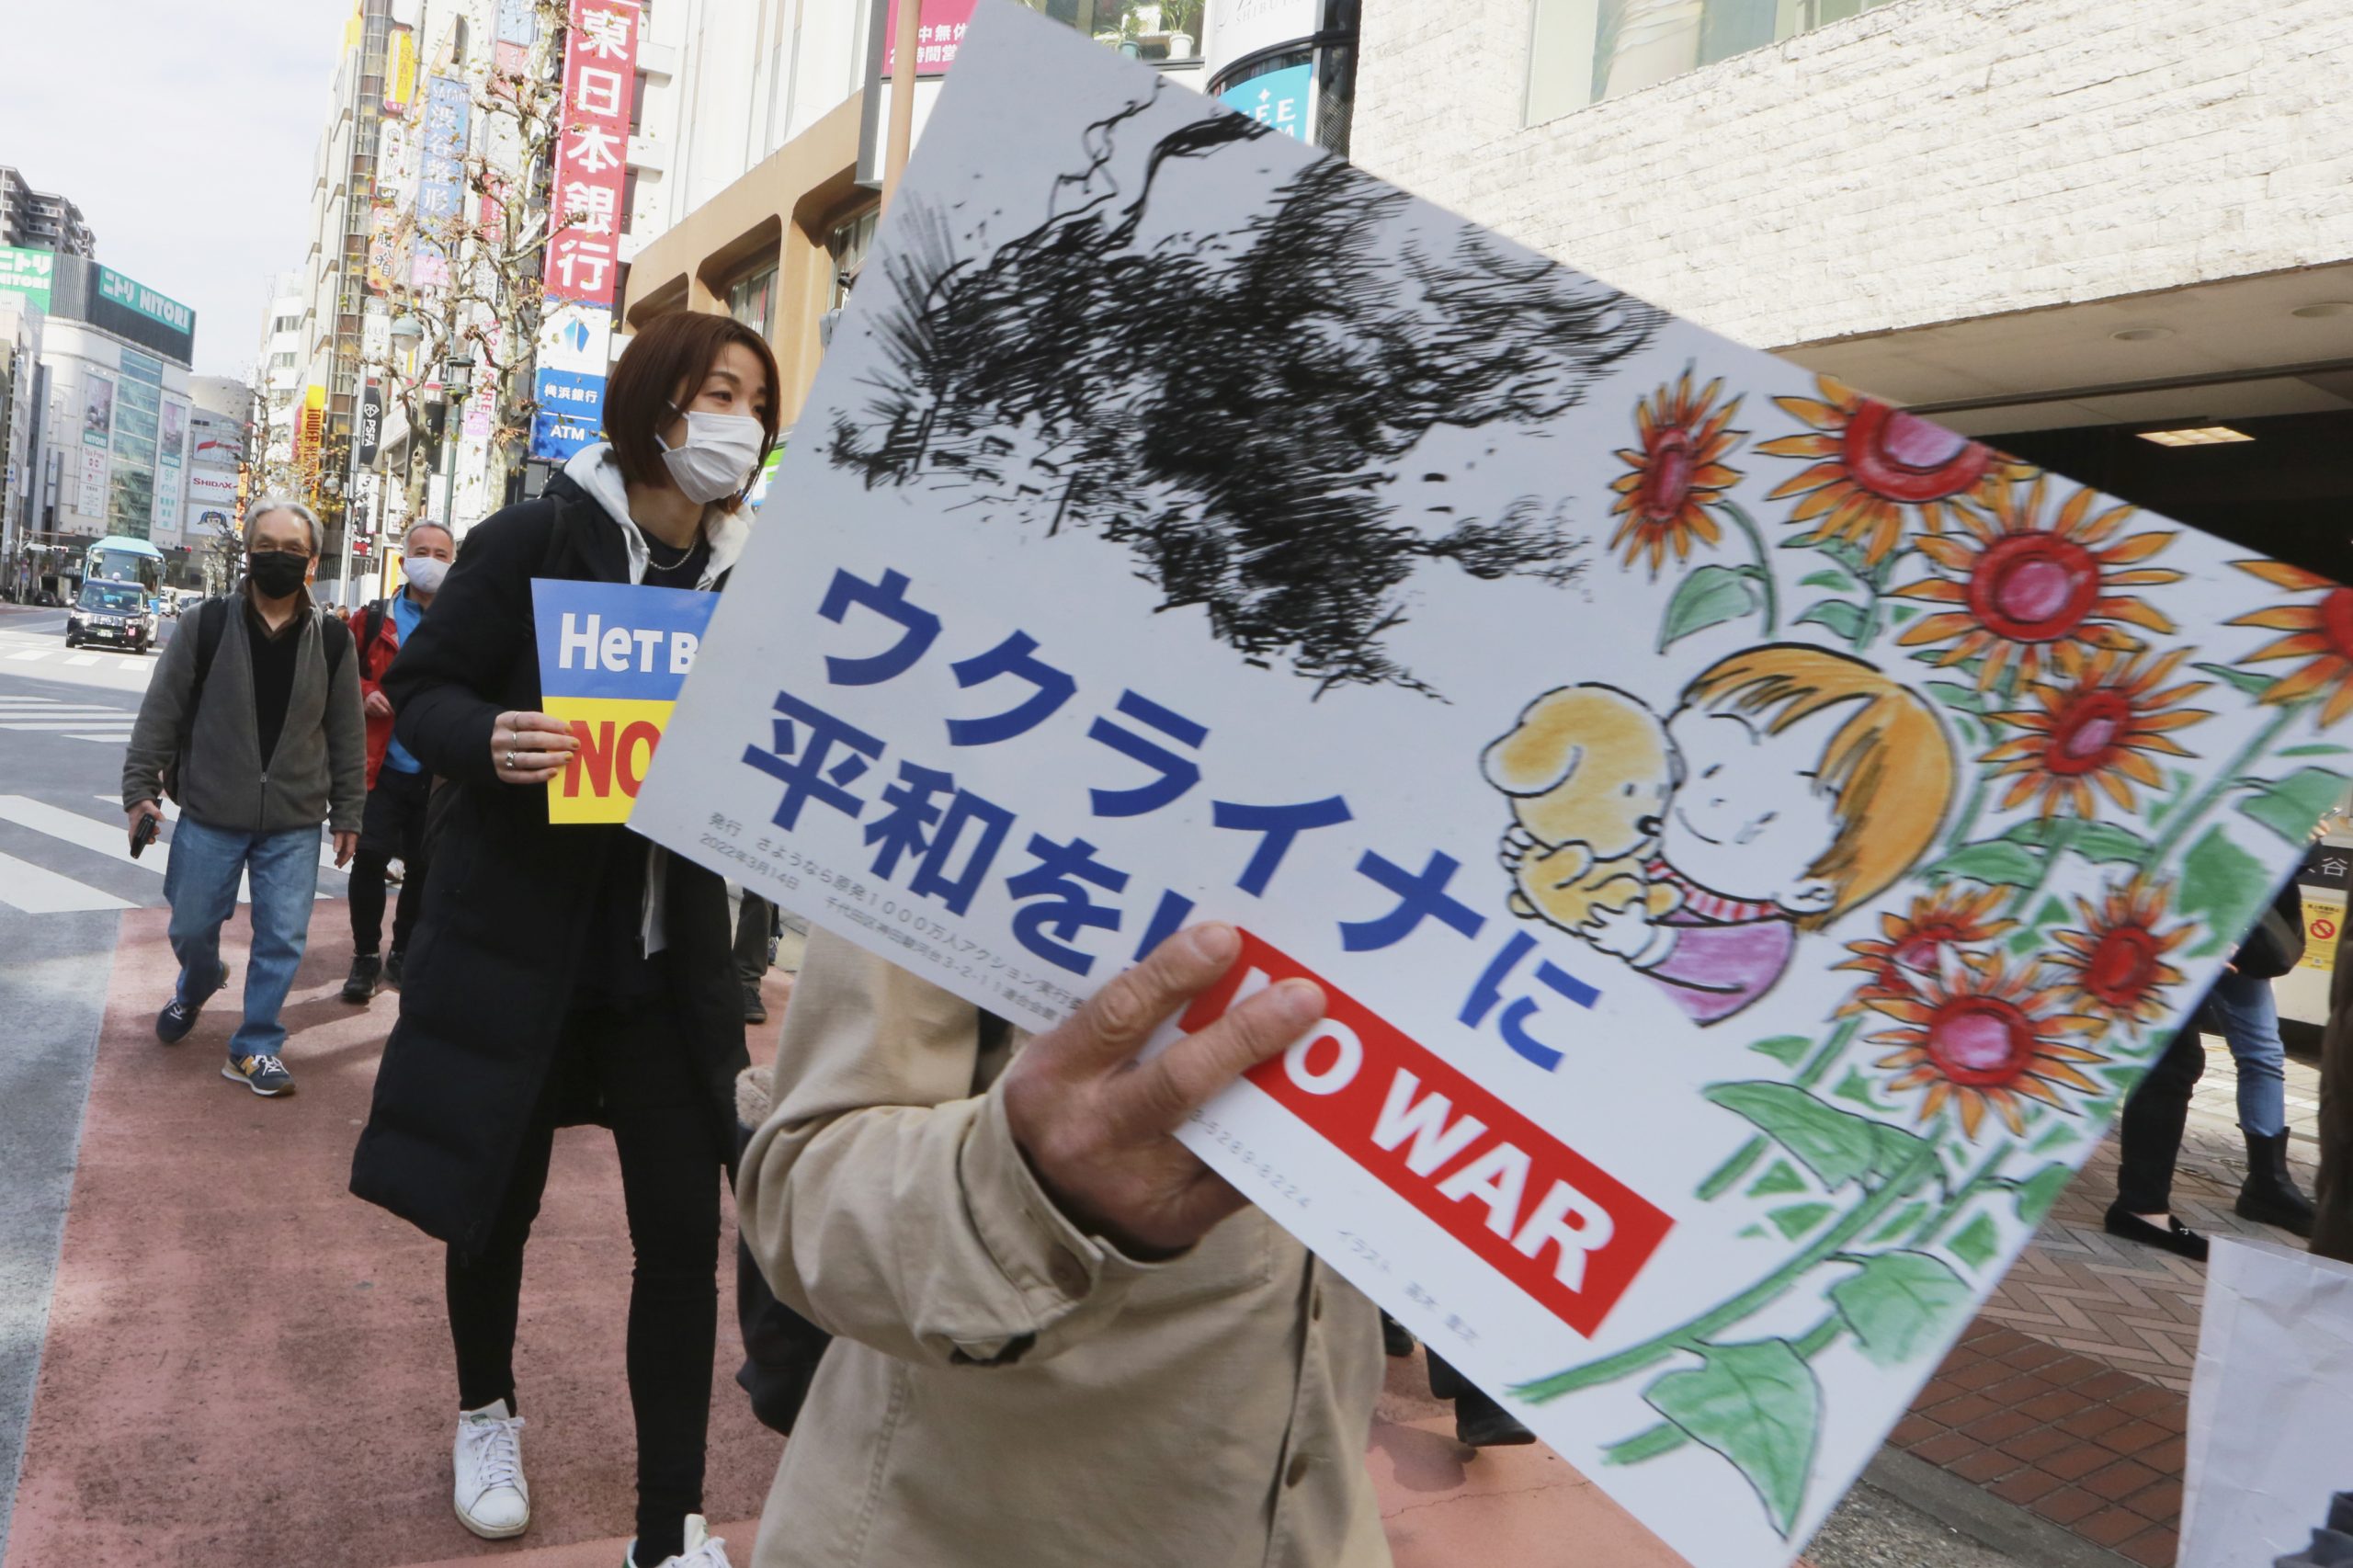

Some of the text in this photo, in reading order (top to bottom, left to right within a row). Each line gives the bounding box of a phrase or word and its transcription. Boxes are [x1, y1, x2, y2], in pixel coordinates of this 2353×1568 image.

[557, 9, 631, 292] 東日本銀行
[0, 250, 51, 275] ニトリ
[103, 270, 135, 304] ニトリ
[139, 287, 189, 330] NITORI
[544, 381, 598, 404] 横浜銀行
[306, 408, 322, 442] TOWER
[365, 418, 377, 448] PSFA
[551, 425, 585, 441] ATM
[193, 477, 233, 490] SHIDAX
[563, 720, 662, 799] NO
[817, 567, 1602, 1073] ウクライナに
[1223, 965, 1616, 1295] O WAR
